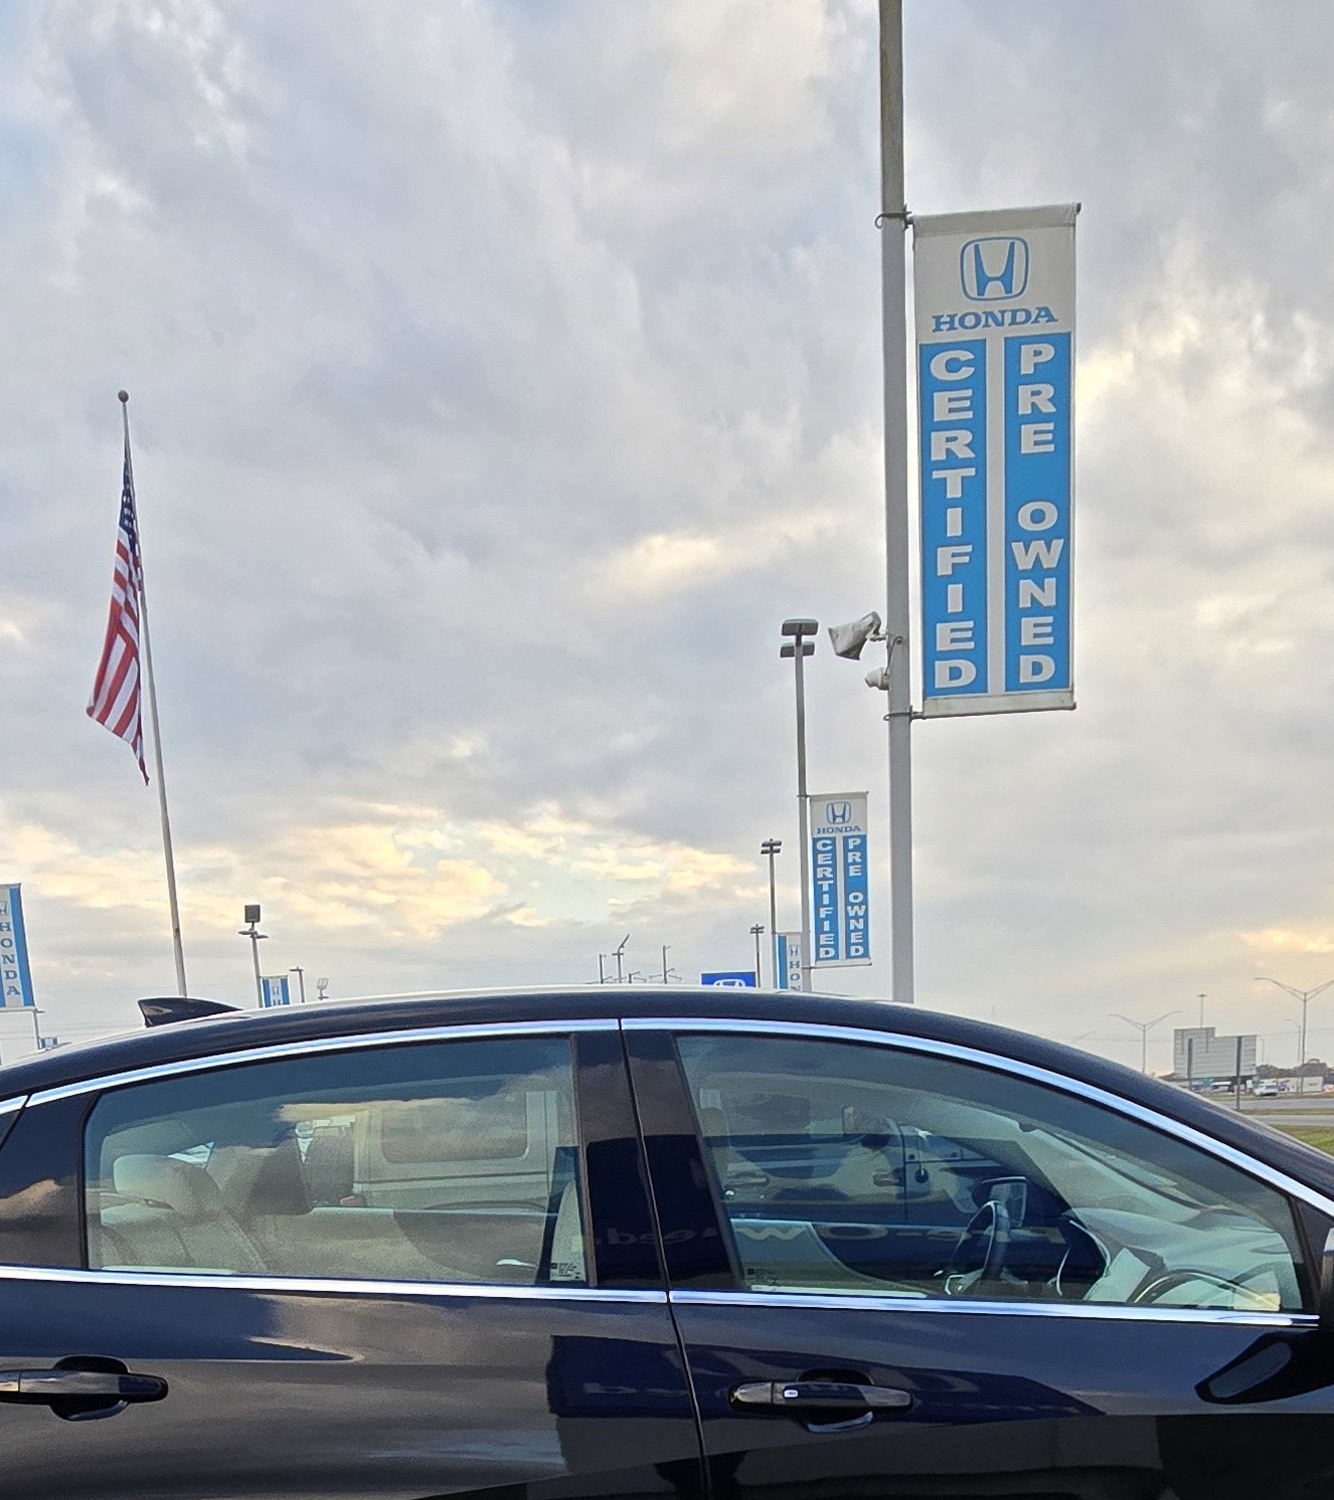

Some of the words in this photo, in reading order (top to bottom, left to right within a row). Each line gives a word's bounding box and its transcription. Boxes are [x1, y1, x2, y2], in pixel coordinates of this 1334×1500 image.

[931, 306, 1058, 333] HONDA
[1017, 342, 1057, 455] PRE
[929, 349, 977, 690] CERTIFIED
[1011, 500, 1065, 684] OWNED
[817, 825, 861, 834] HONDA
[847, 837, 862, 876] PRE
[816, 839, 835, 959] CERTIFIED
[846, 892, 866, 957] OWNED
[789, 960, 801, 991] HON
